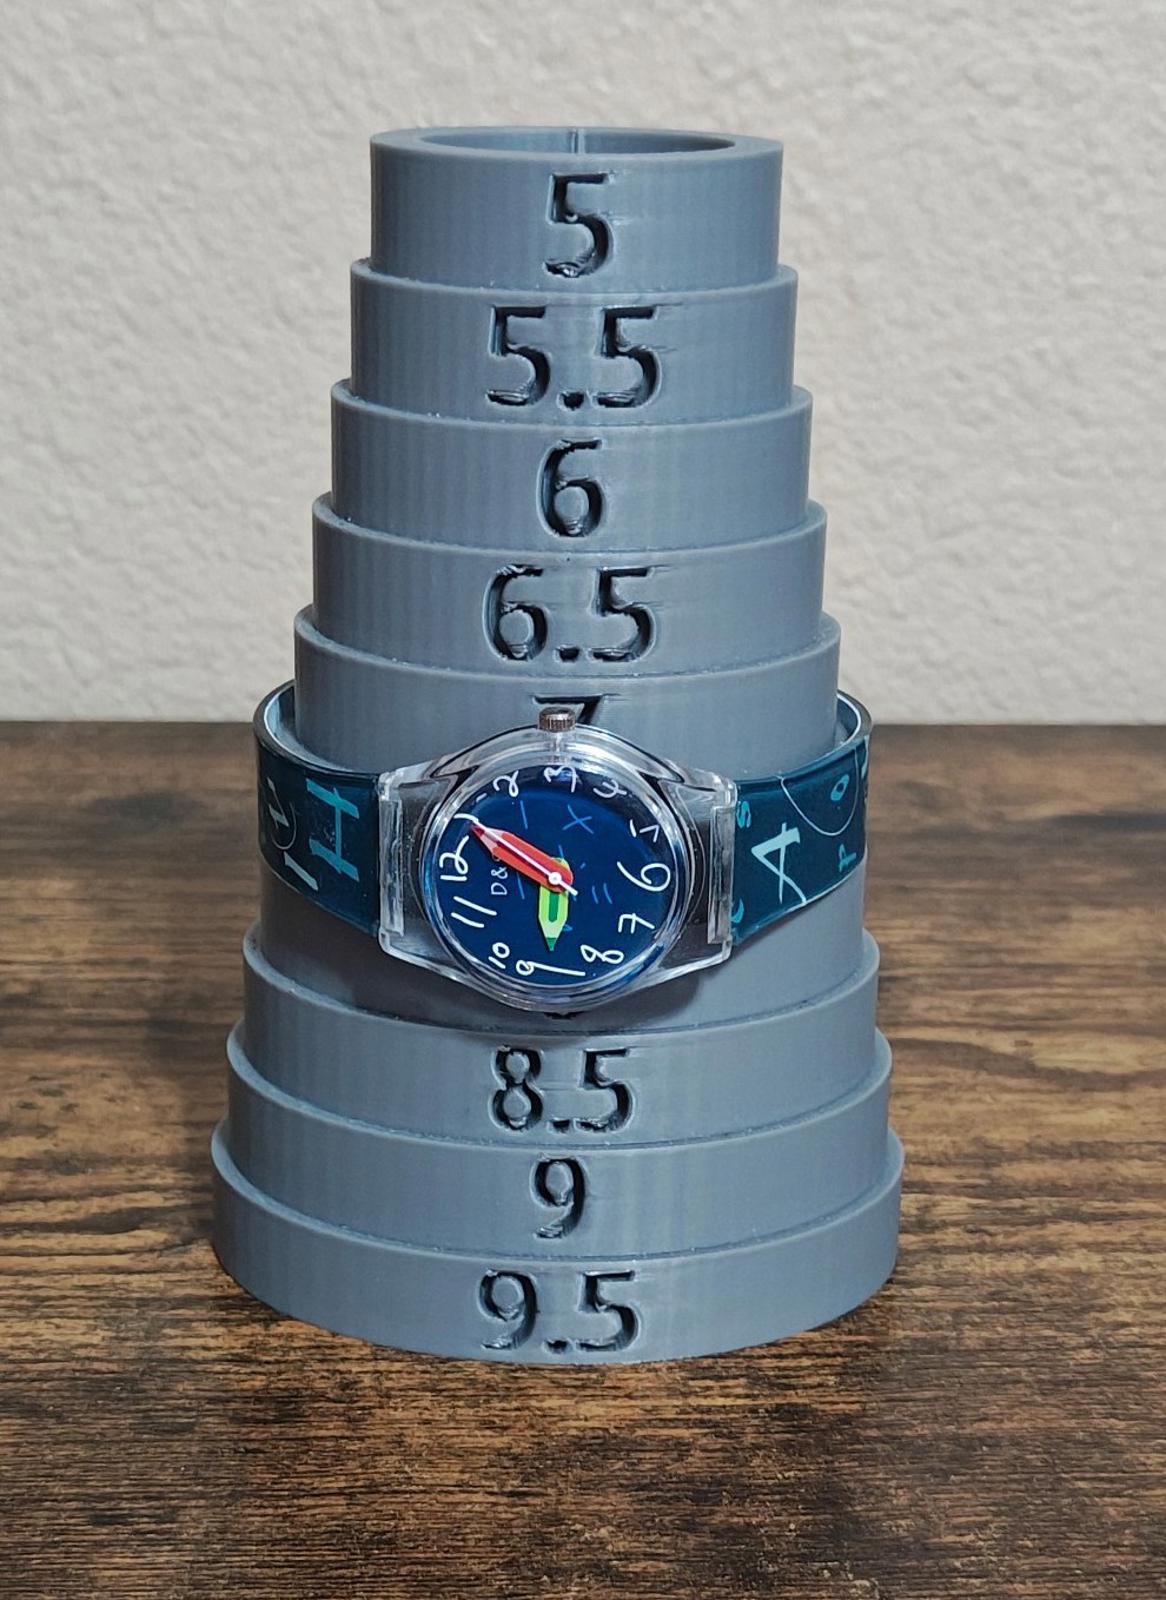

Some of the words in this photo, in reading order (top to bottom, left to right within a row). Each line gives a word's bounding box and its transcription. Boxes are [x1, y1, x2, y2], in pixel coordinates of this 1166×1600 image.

[544, 172, 613, 278] 5
[486, 303, 662, 409] 5.5
[536, 438, 605, 537] 6
[482, 564, 656, 662] 6.5
[493, 770, 519, 797] 2
[439, 835, 469, 882] 12
[617, 861, 671, 892] 6
[451, 896, 497, 928] 11
[618, 913, 655, 934] 7
[488, 942, 510, 969] 10
[580, 944, 624, 964] 8
[487, 1045, 637, 1133] 8.5
[530, 1152, 587, 1238] 9
[477, 1267, 641, 1352] 9.5
